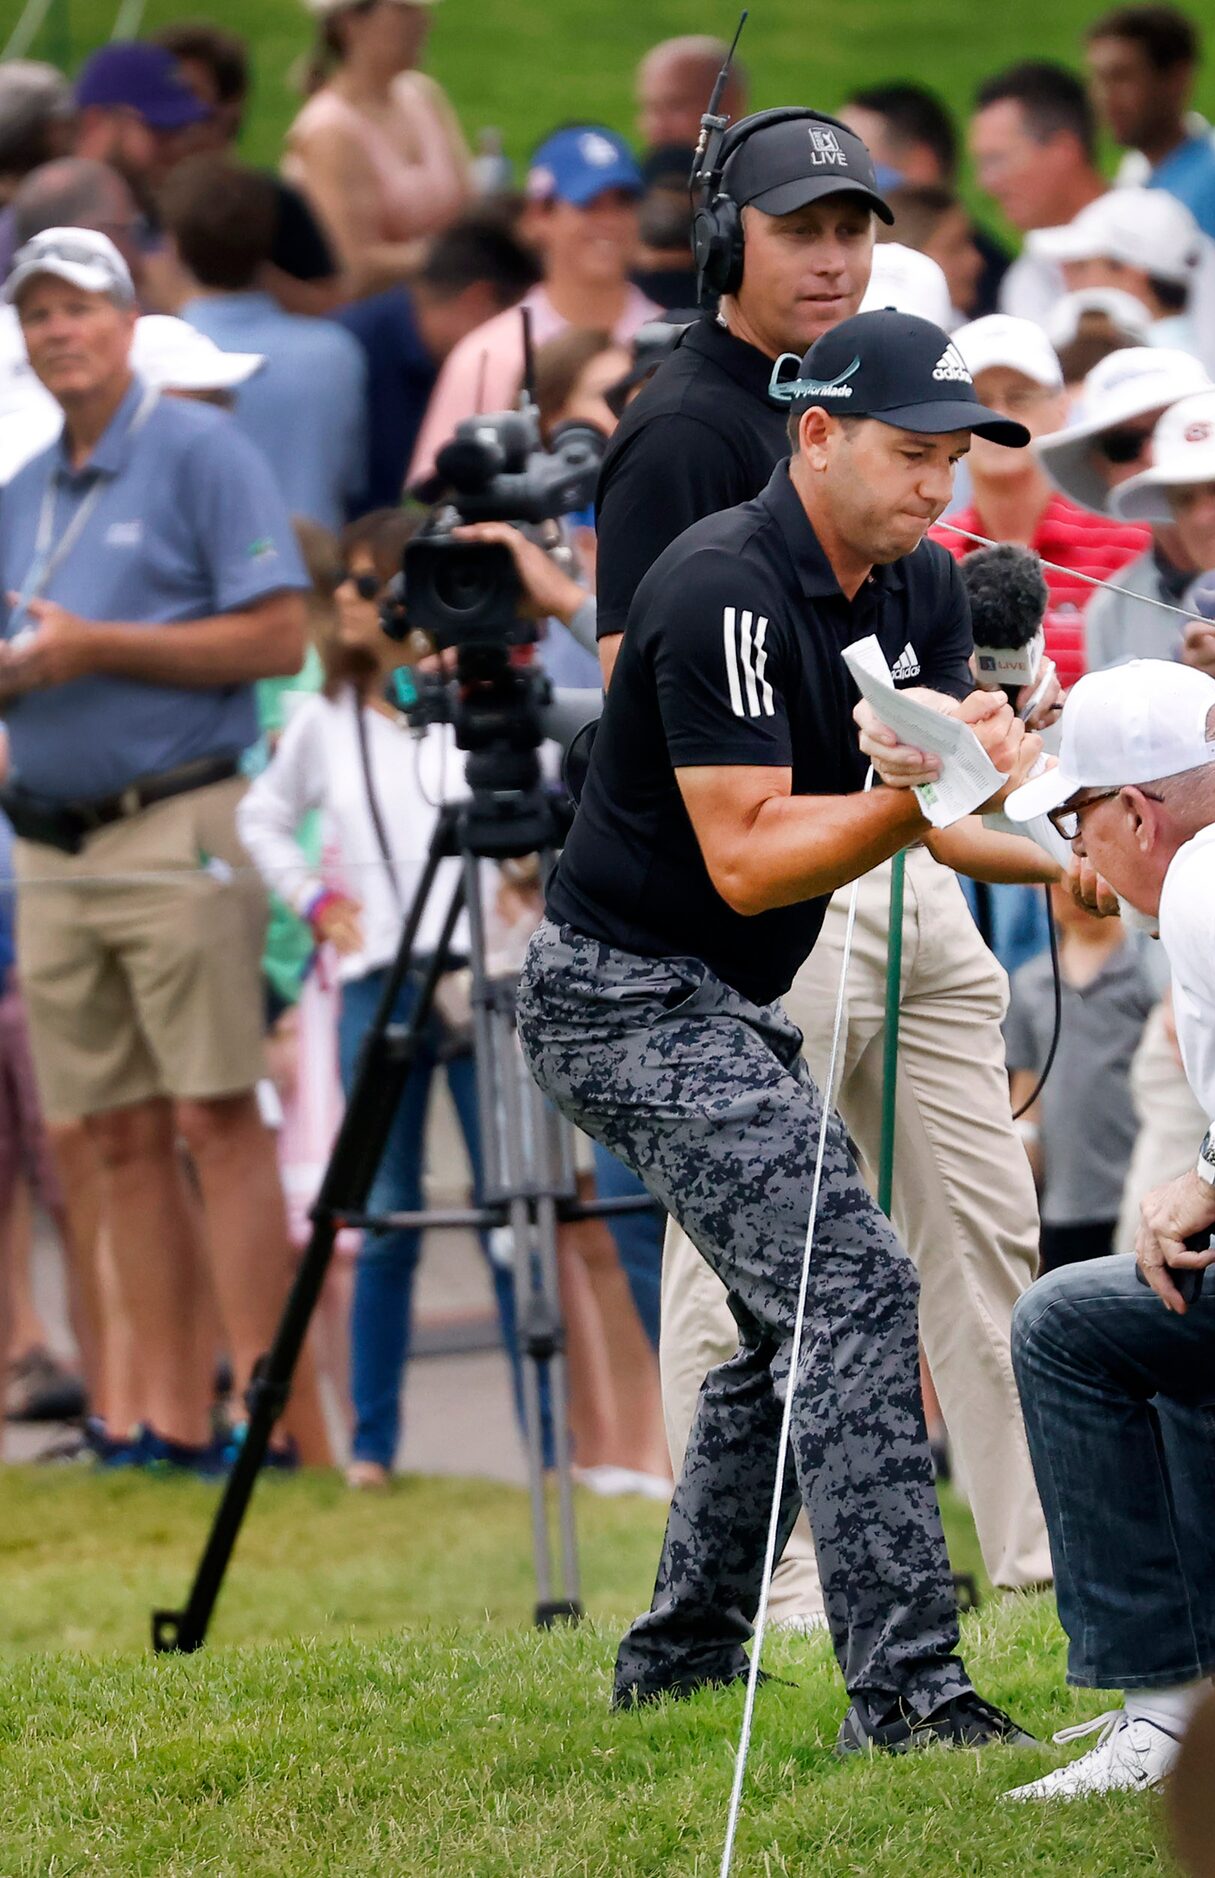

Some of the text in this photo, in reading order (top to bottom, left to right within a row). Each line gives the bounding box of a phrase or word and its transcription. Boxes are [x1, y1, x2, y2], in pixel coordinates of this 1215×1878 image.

[811, 151, 848, 166] LIVE
[794, 383, 853, 398] ylorMade
[998, 660, 1026, 671] LIVE
